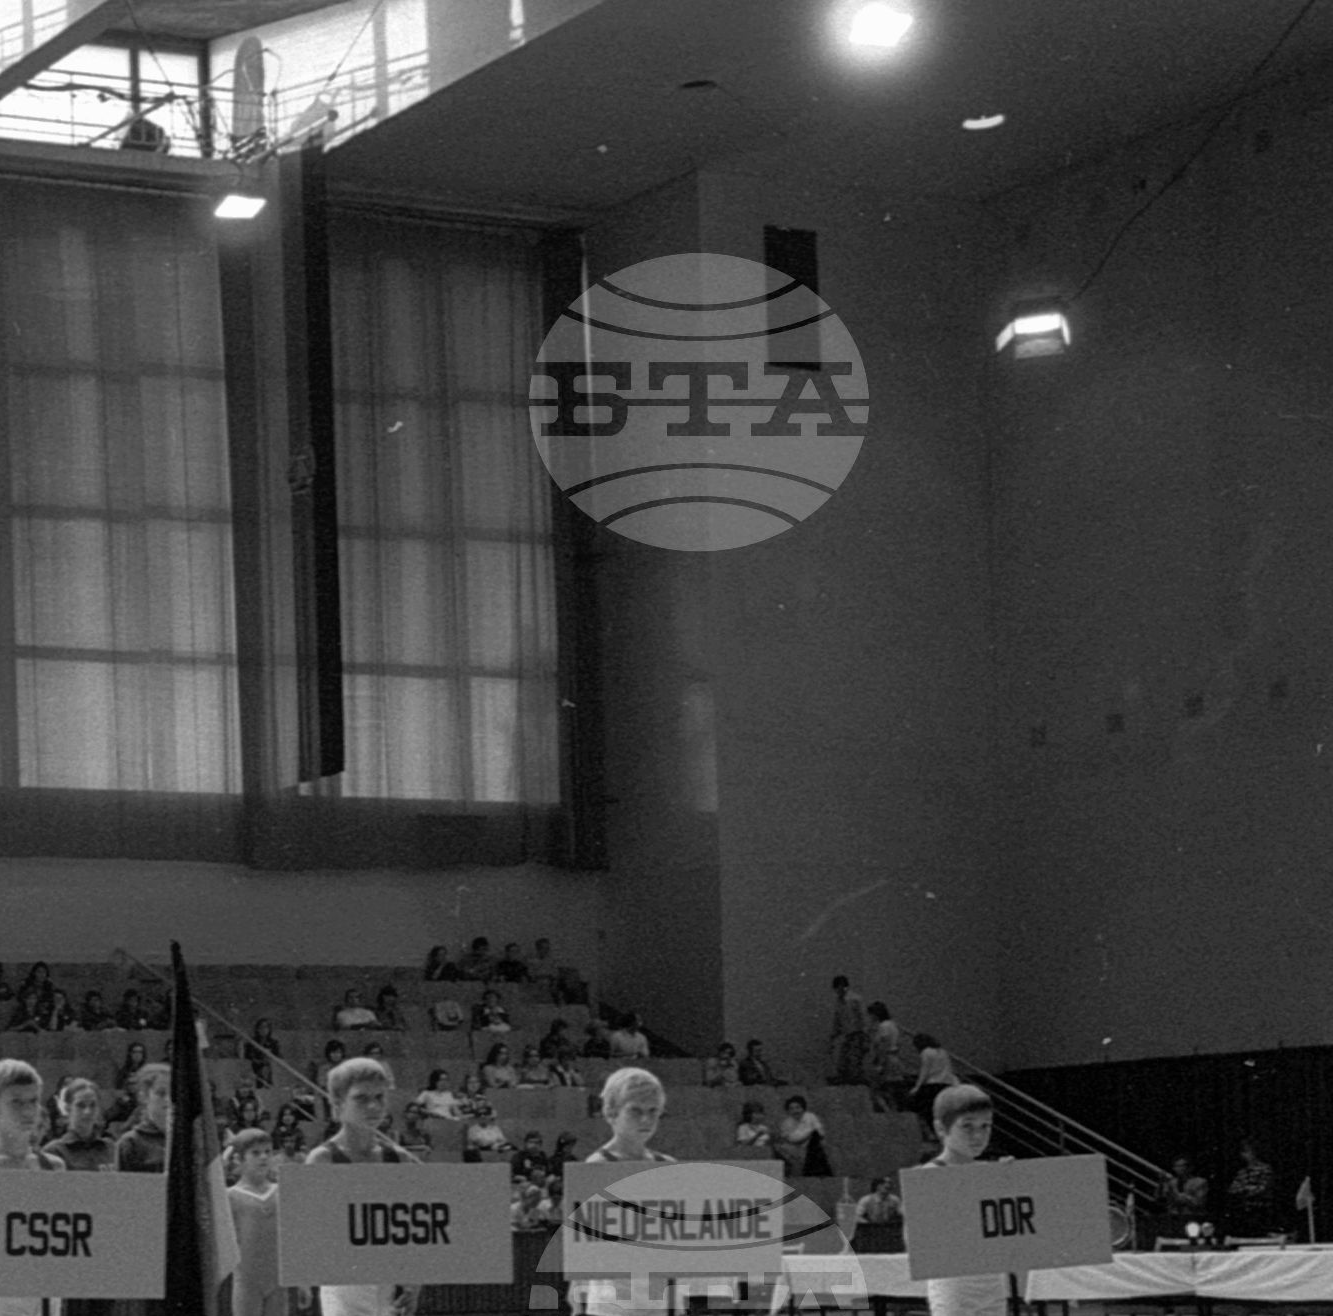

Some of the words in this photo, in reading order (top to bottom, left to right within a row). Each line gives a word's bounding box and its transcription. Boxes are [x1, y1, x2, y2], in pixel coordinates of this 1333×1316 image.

[5, 1211, 93, 1257] CSSR
[348, 1202, 450, 1247] UDSSR
[571, 1197, 773, 1243] NIEDERLANDE
[981, 1196, 1037, 1239] DDR
